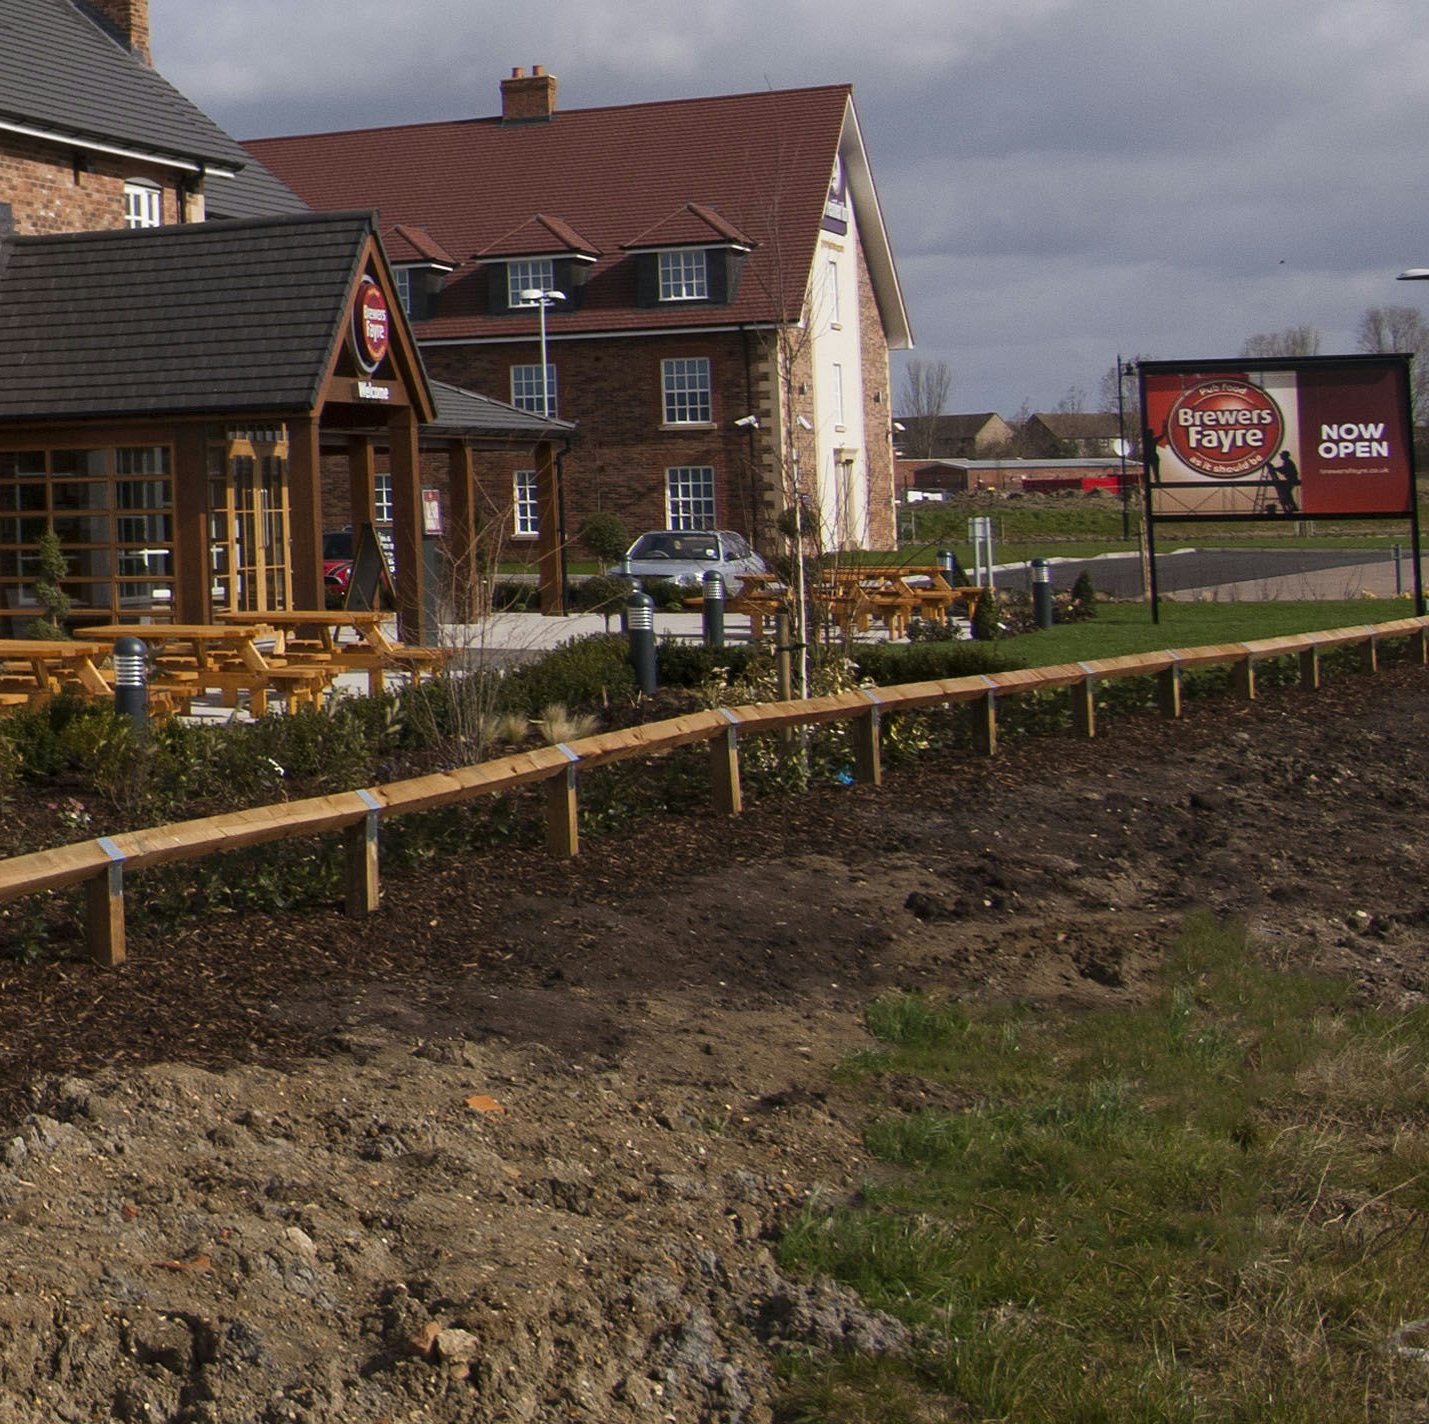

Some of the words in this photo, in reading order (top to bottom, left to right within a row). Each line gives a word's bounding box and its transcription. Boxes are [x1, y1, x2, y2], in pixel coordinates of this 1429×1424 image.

[358, 381, 390, 400] Welcome
[1178, 408, 1273, 426] Brewers
[1188, 426, 1263, 453] Fayre
[1321, 423, 1384, 440] NOW
[1317, 441, 1388, 458] OPEN
[1213, 461, 1249, 473] should
